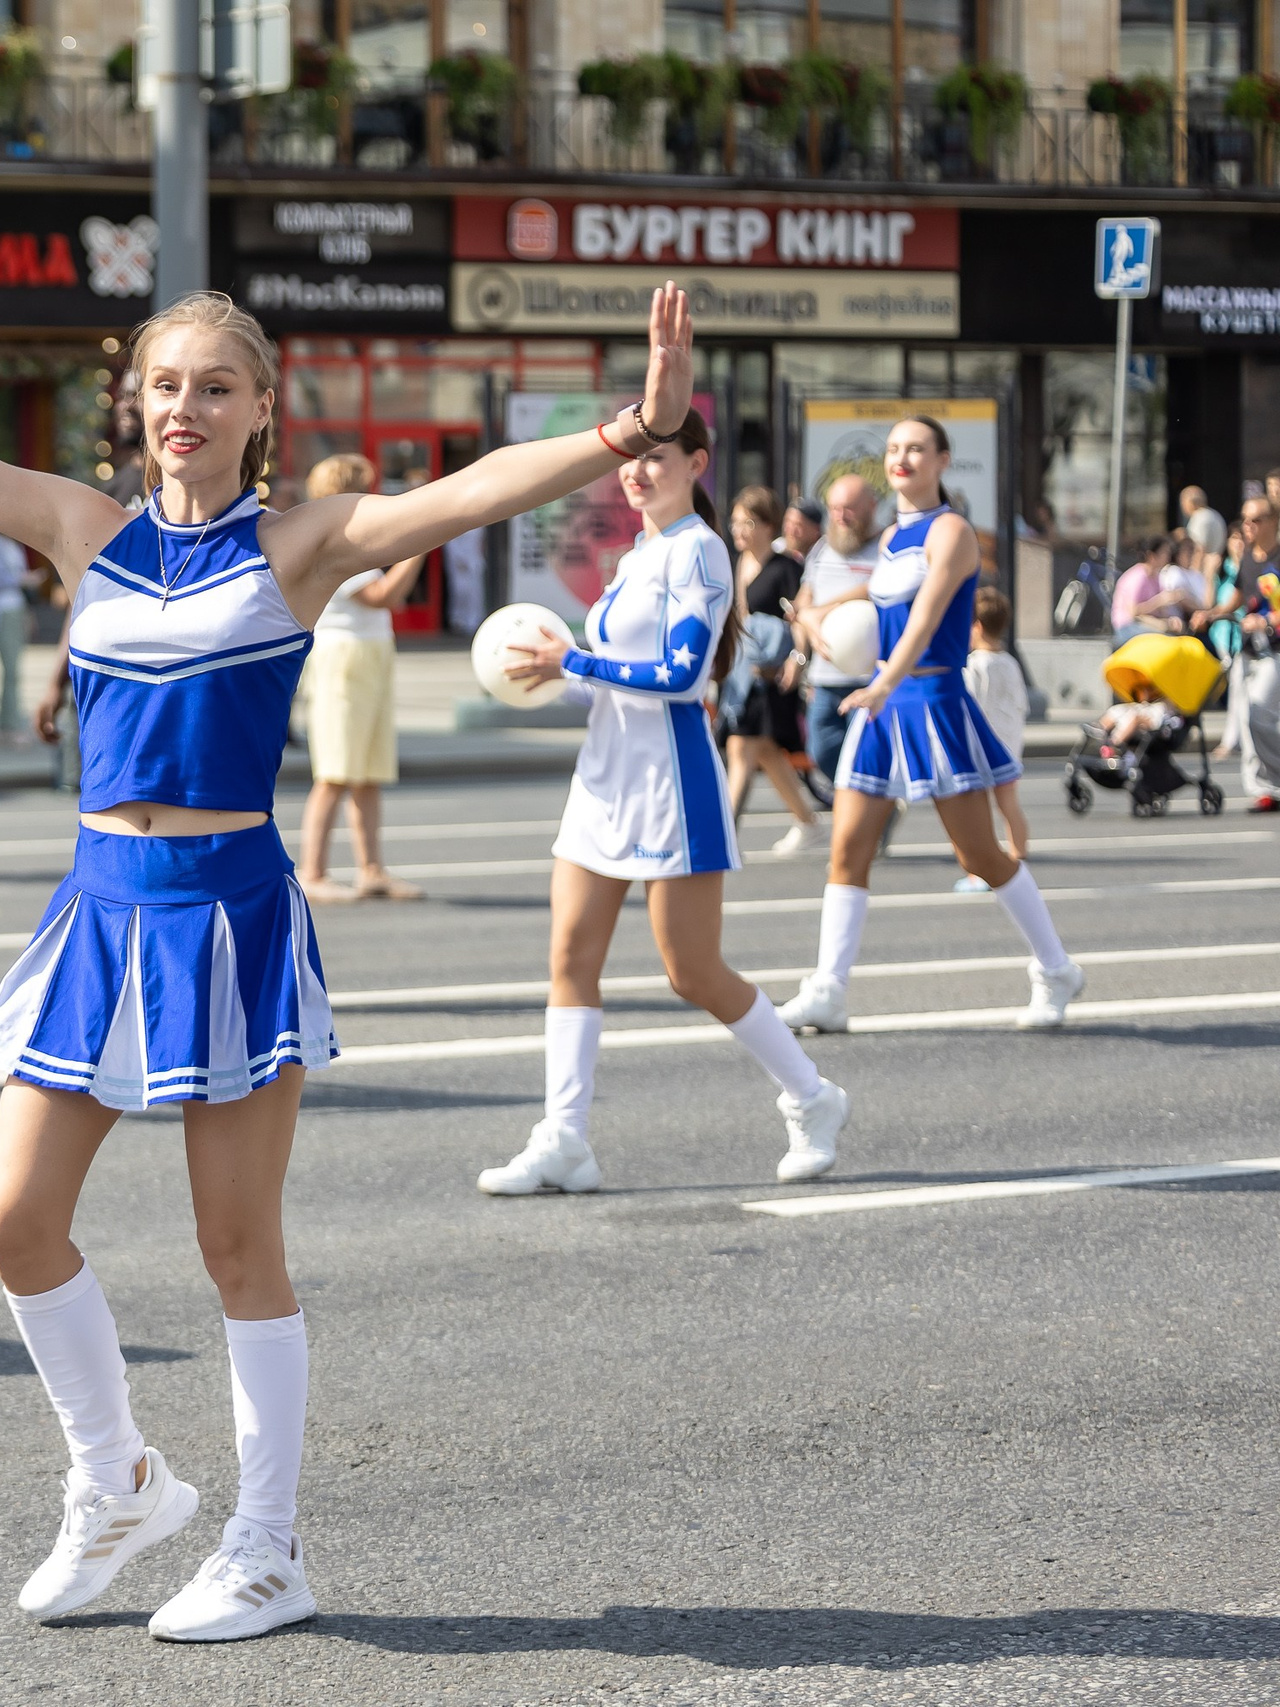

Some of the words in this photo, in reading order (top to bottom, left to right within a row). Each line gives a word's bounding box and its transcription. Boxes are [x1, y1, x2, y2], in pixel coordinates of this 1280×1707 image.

[320, 232, 372, 265] КЛУБ
[572, 203, 770, 264] БУРГЕР
[776, 208, 916, 267] КИНГ
[247, 273, 445, 312] #МосКальян
[523, 276, 818, 322] Шоколдница
